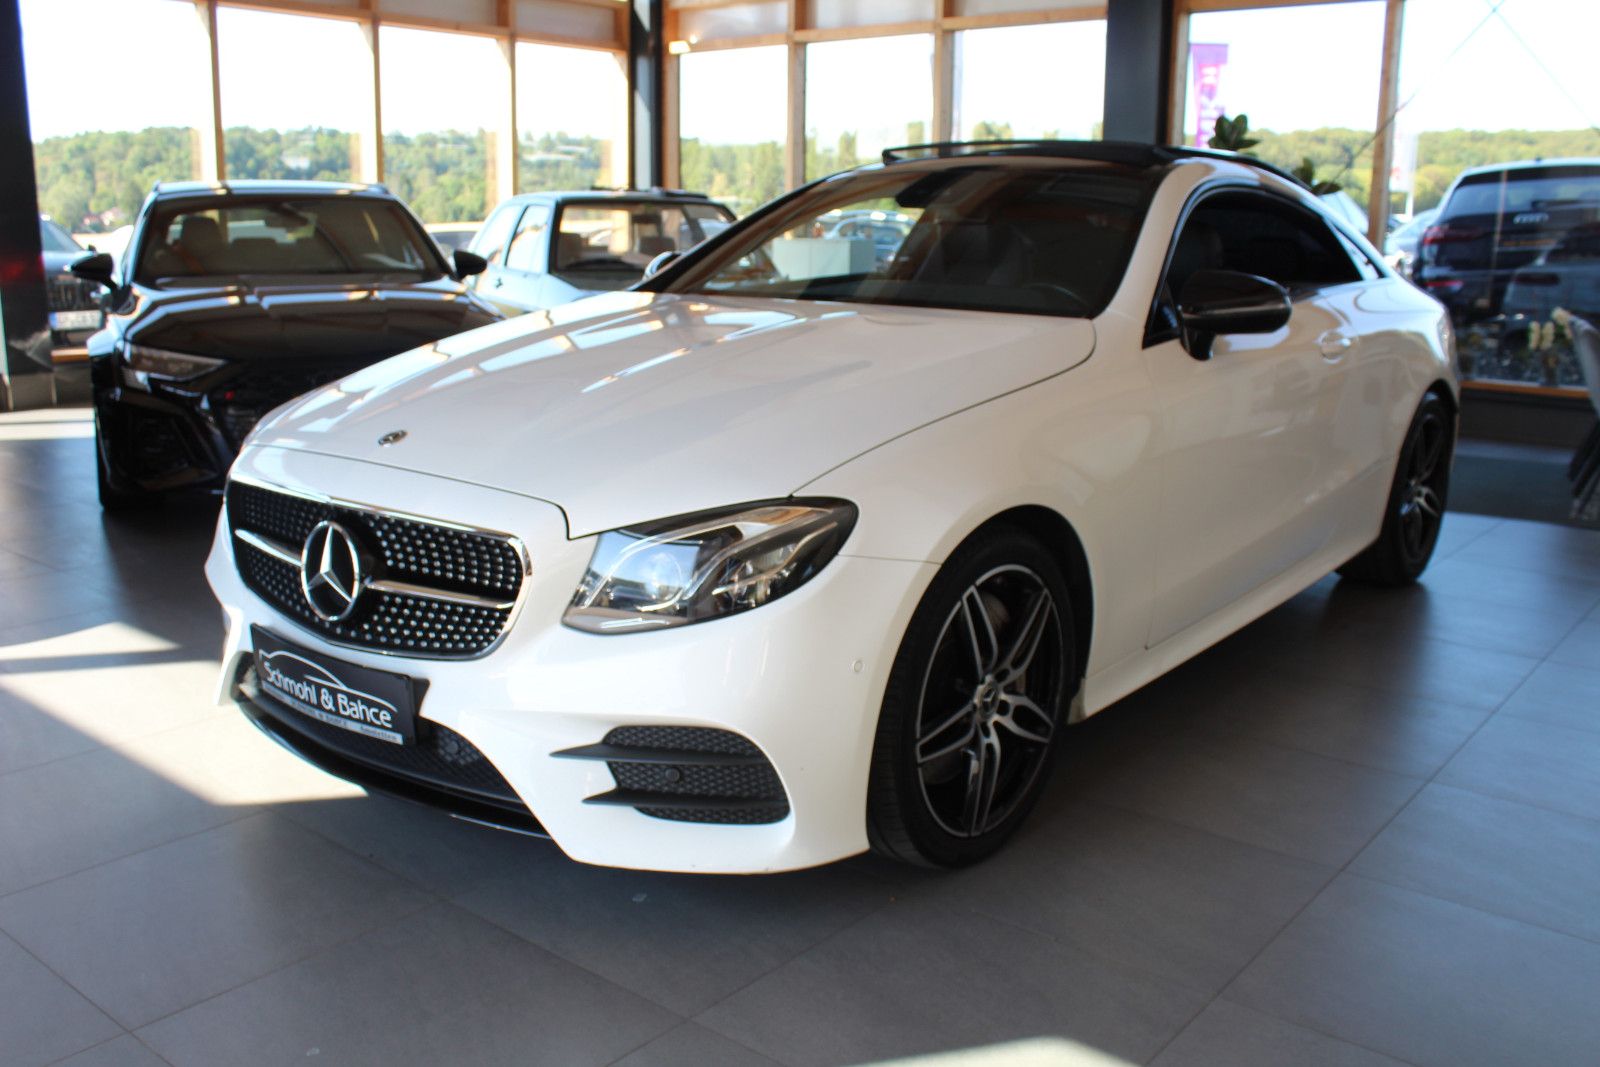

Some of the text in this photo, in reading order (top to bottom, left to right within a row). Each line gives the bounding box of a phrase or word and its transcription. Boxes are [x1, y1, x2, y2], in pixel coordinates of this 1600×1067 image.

[263, 661, 318, 706] Schmohl
[320, 687, 336, 712] &
[337, 693, 393, 729] Bahce
